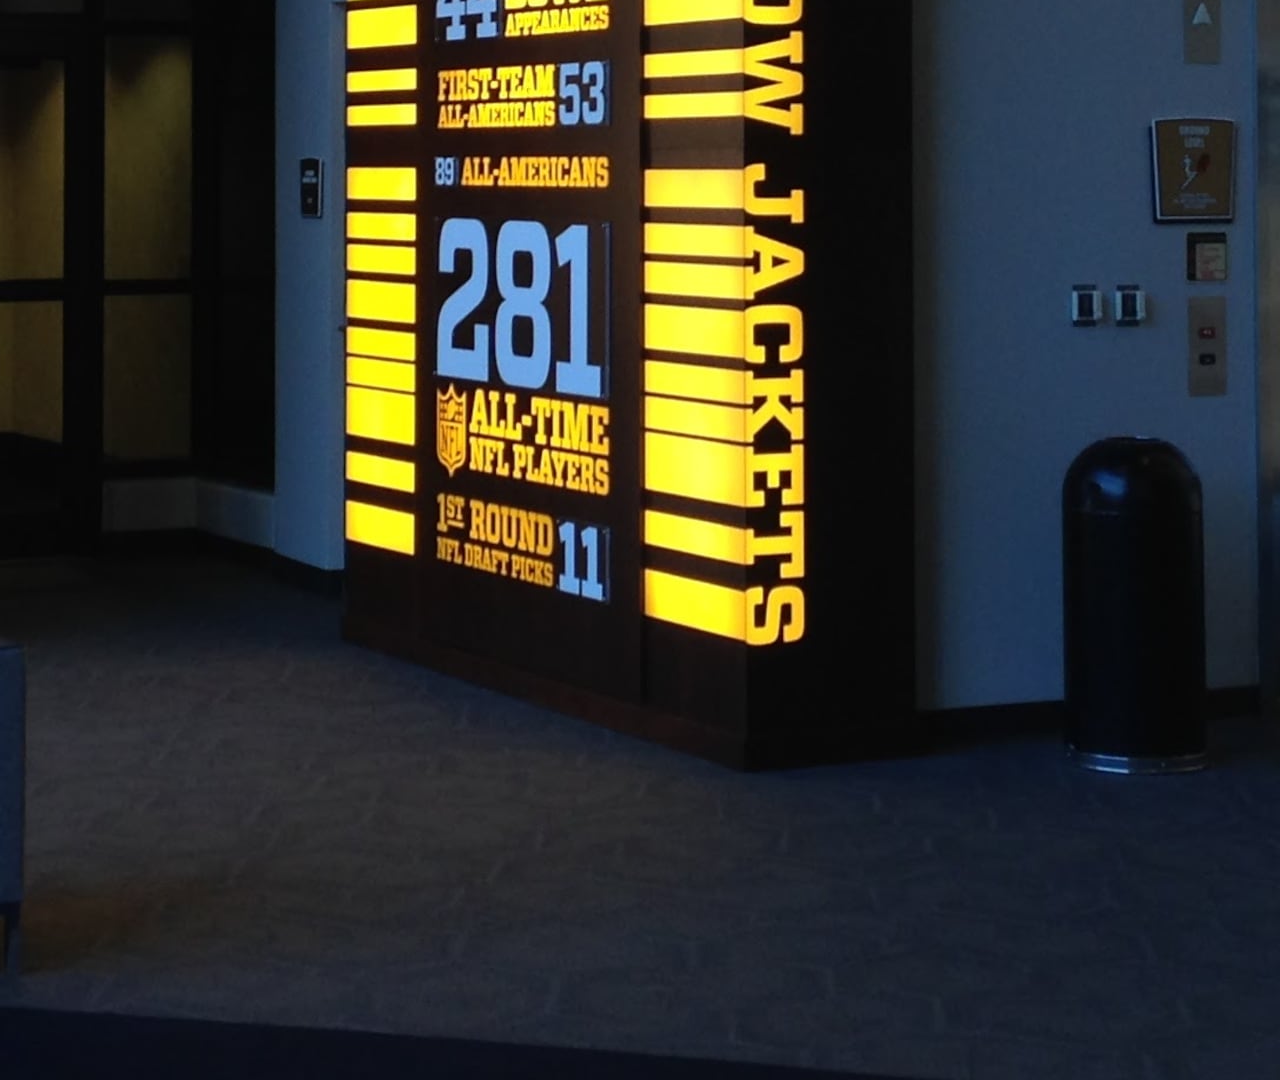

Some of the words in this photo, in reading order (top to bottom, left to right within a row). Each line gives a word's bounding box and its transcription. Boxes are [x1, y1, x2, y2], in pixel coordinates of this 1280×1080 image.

[505, 5, 609, 37] APPEARANCES
[438, 64, 555, 101] FIRST-TEAM
[559, 61, 604, 125] 53
[438, 100, 555, 128] ALL-AMERICANS
[435, 157, 454, 185] 89
[461, 156, 609, 188] ALL-AMERICANS
[437, 218, 601, 398] 281
[469, 389, 609, 456] ALL-TIME
[743, 163, 804, 645] JACKETS
[469, 440, 509, 476] NFL
[512, 444, 609, 495] PLAYERS
[470, 500, 553, 556] ROUND
[437, 537, 462, 564] NFL
[464, 543, 509, 575] DRAFT
[511, 554, 553, 586] PICKS
[559, 522, 603, 600] 11
